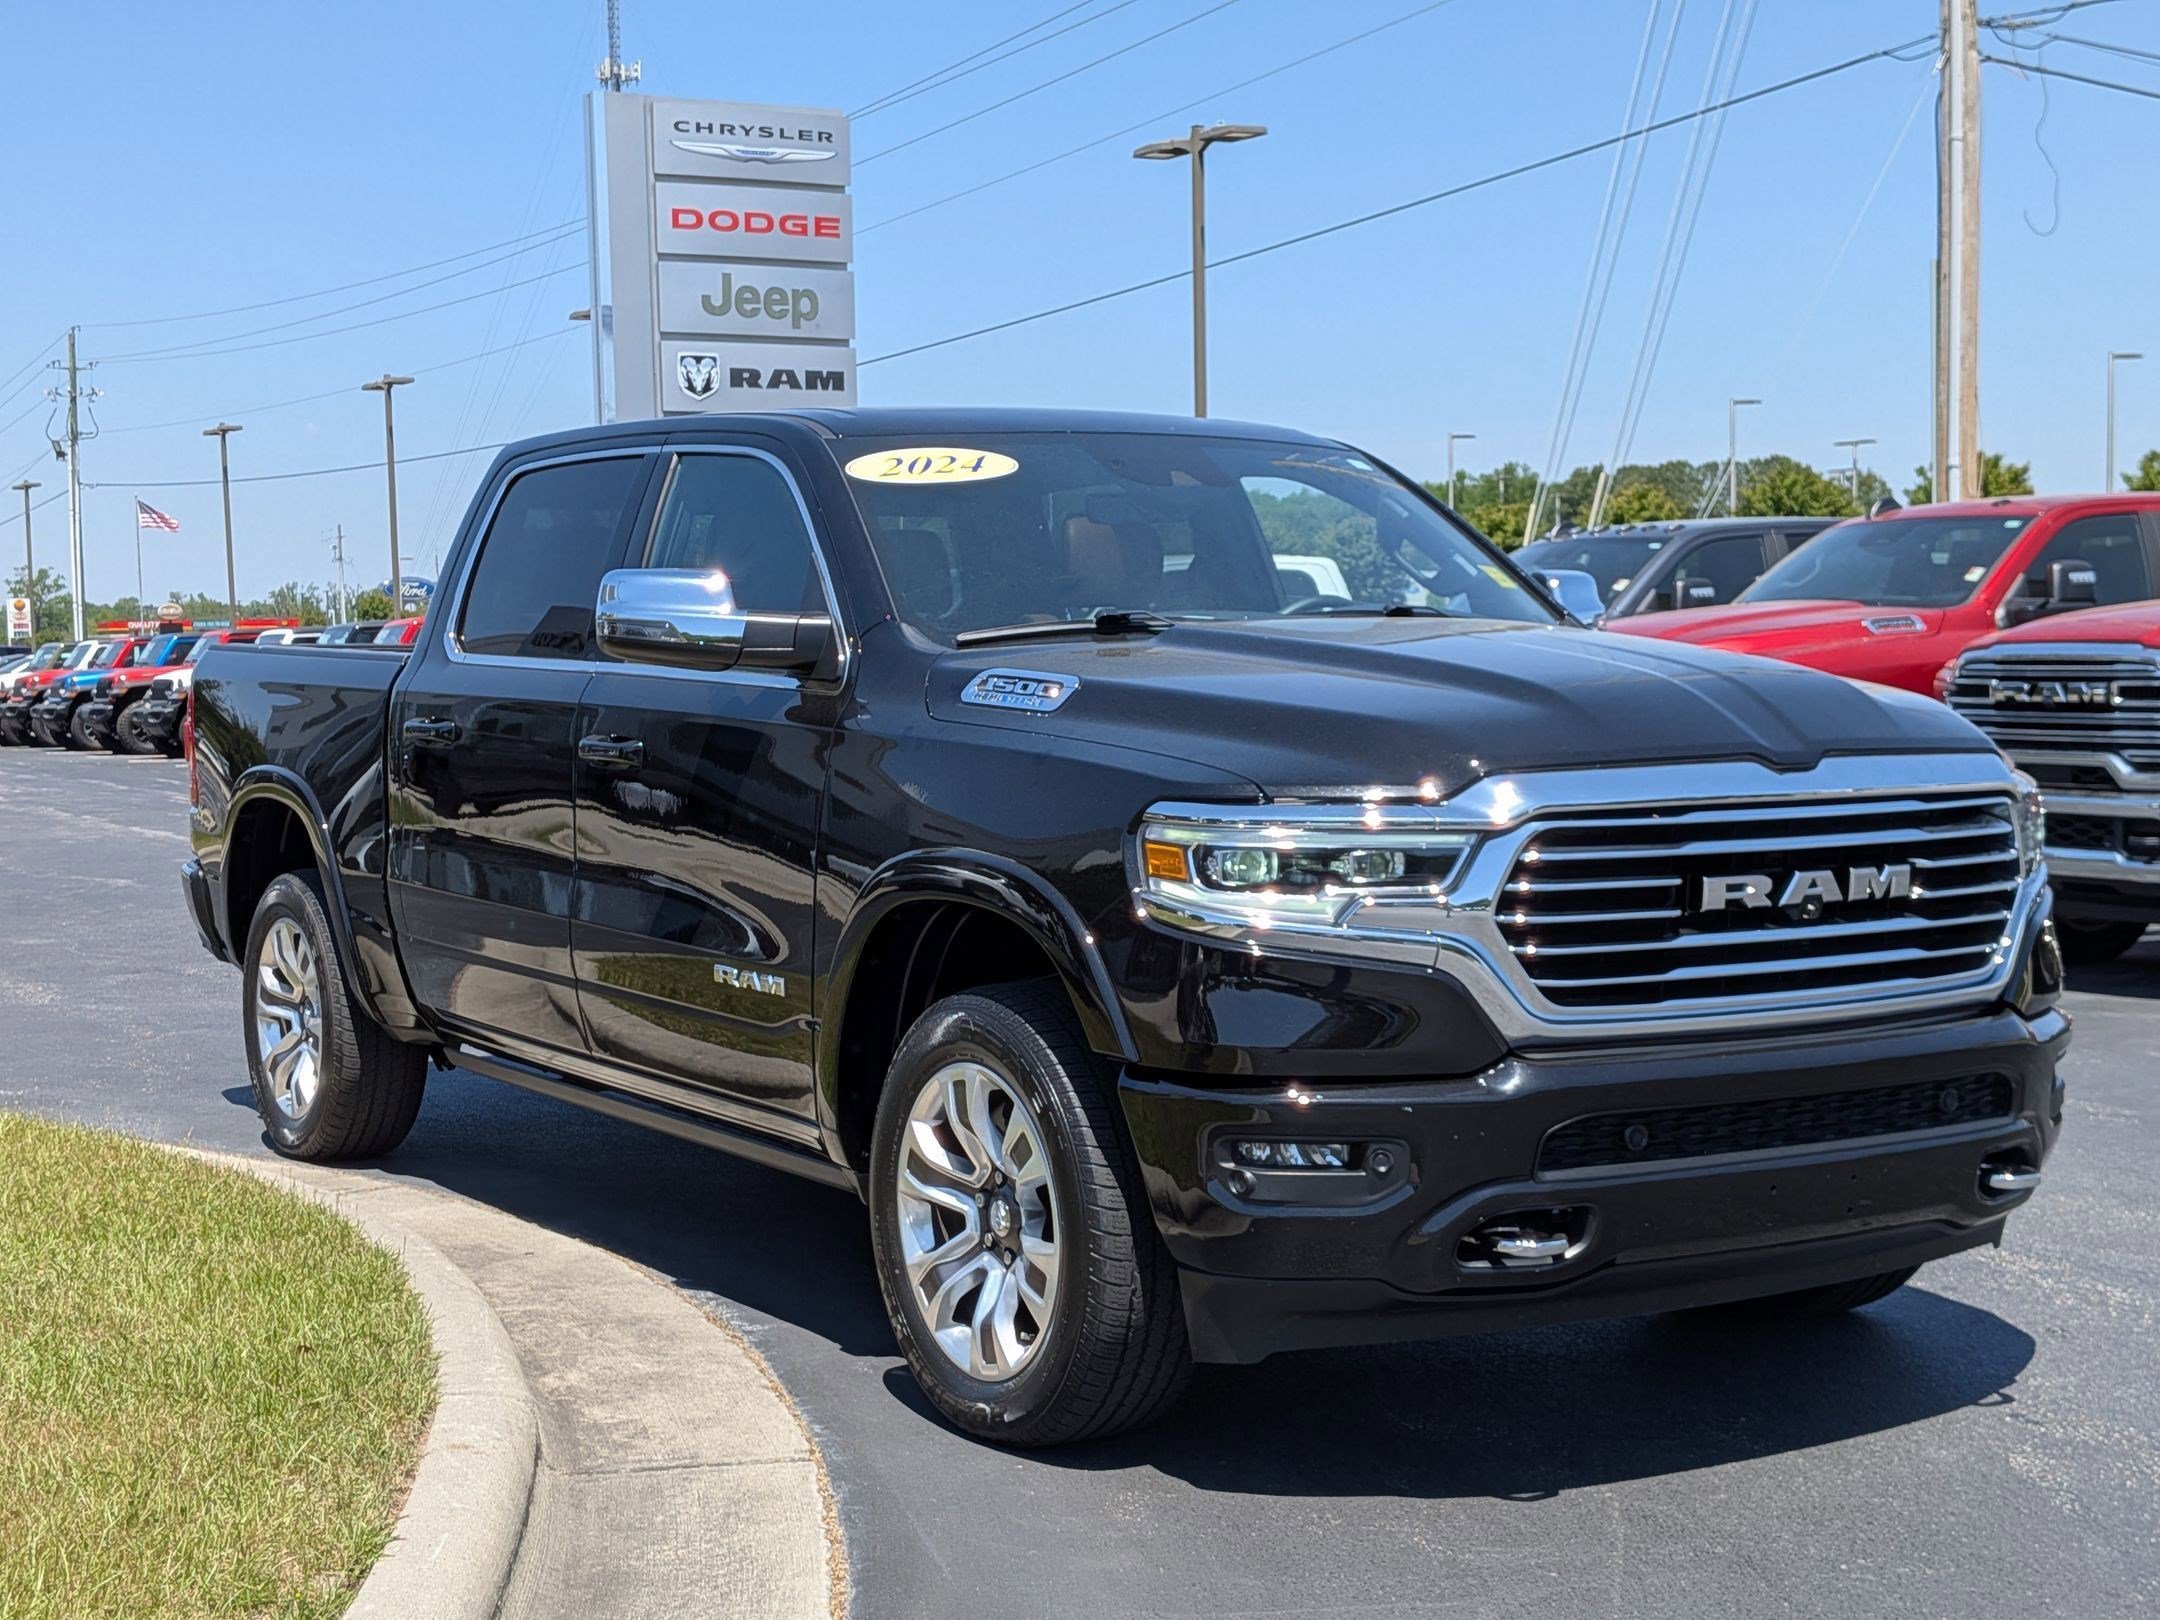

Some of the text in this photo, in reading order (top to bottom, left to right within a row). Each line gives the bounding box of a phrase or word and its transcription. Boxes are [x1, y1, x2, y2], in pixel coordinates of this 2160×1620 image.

[673, 120, 834, 143] CHRYSLER
[672, 208, 840, 238] DODGE
[701, 272, 819, 329] Jeep
[729, 367, 845, 391] RAM
[879, 455, 986, 477] 2024
[1994, 681, 2108, 702] RAM
[1700, 863, 1911, 912] RAM
[713, 963, 785, 997] RAM
